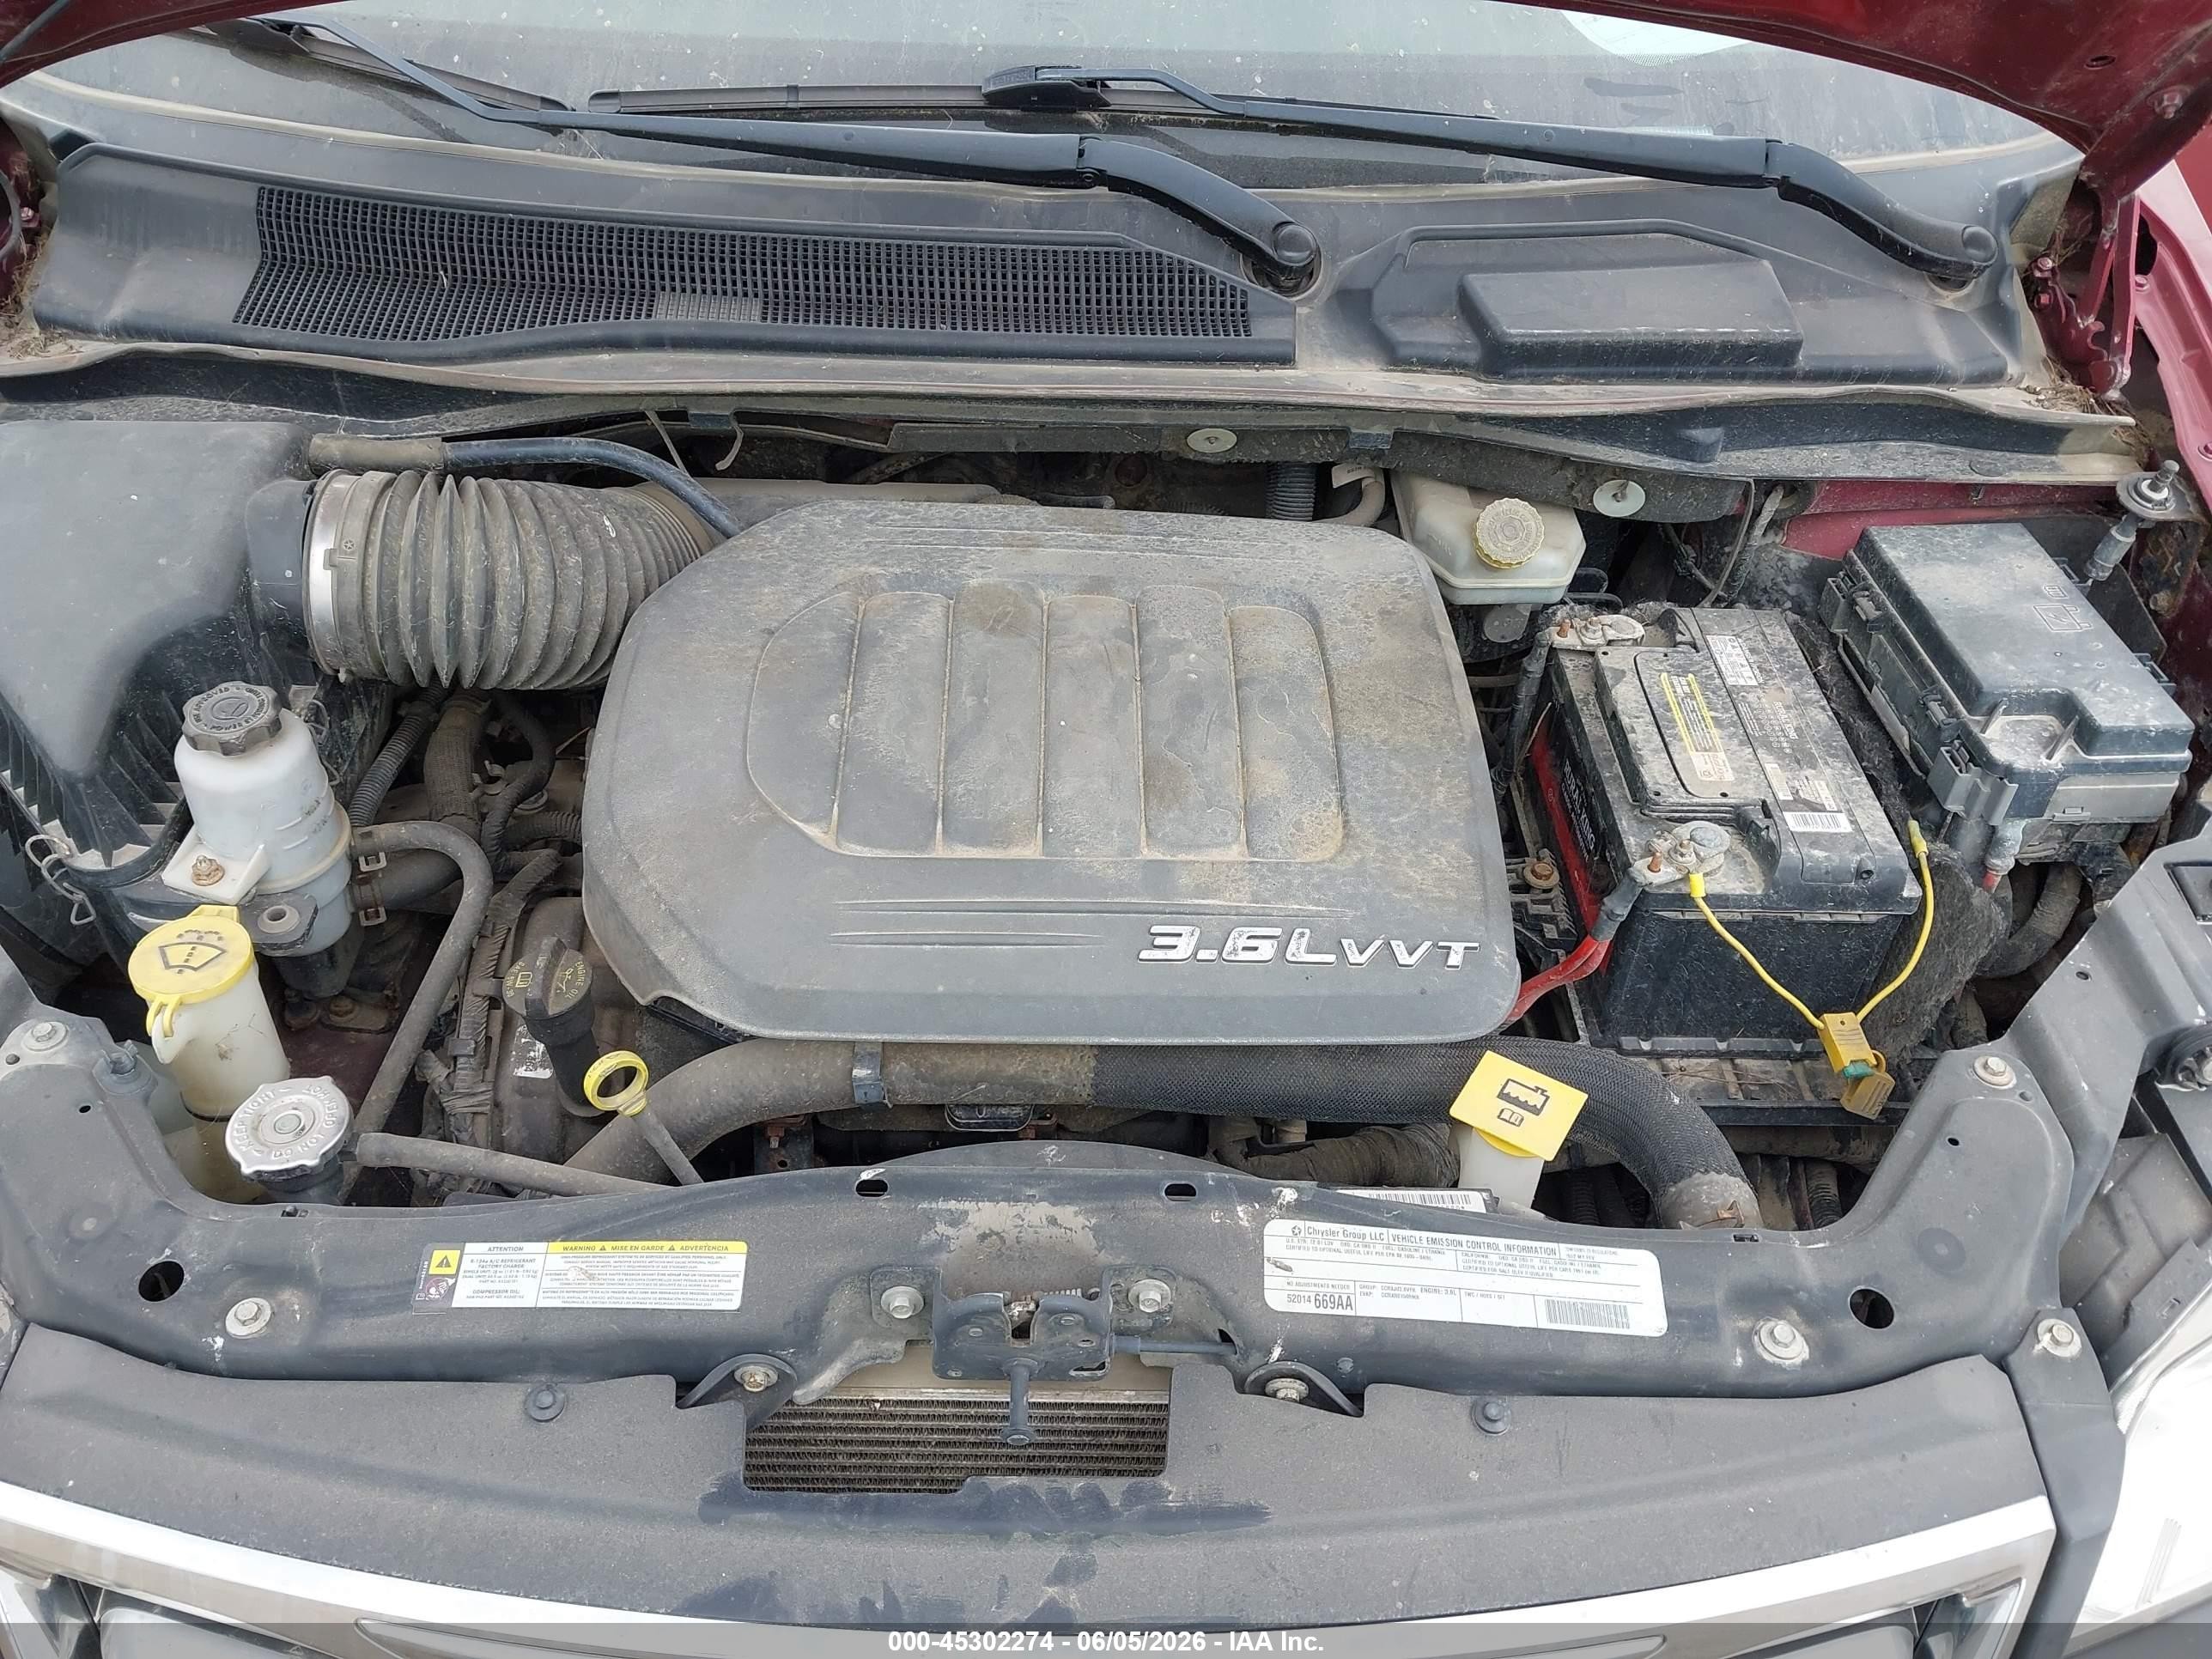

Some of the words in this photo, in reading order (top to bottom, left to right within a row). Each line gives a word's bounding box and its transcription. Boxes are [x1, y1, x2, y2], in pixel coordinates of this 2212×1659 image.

[194, 687, 229, 712] APPROVED
[210, 722, 243, 731] POWER
[1564, 757, 1583, 814] RURAL
[1578, 807, 1595, 851] KING
[1340, 937, 1480, 970] VVT
[575, 961, 586, 986] ENGINE
[565, 988, 579, 999] OIL
[302, 1085, 331, 1098] HOT
[323, 1099, 338, 1128] OPEN
[234, 1121, 254, 1151] KEEP
[298, 1133, 325, 1152] NOT
[272, 1148, 293, 1160] DO
[1307, 1226, 1340, 1238] Chrysler
[1343, 1229, 1367, 1241] Group
[1370, 1231, 1384, 1242] LLC
[1391, 1234, 1424, 1244] VEHICLE
[1426, 1237, 1463, 1248] EMISSION
[1466, 1240, 1501, 1251] CONTROL
[1504, 1243, 1557, 1256] INFORMATION
[1287, 1294, 1311, 1304] 52014
[1314, 1293, 1353, 1310] 669AA
